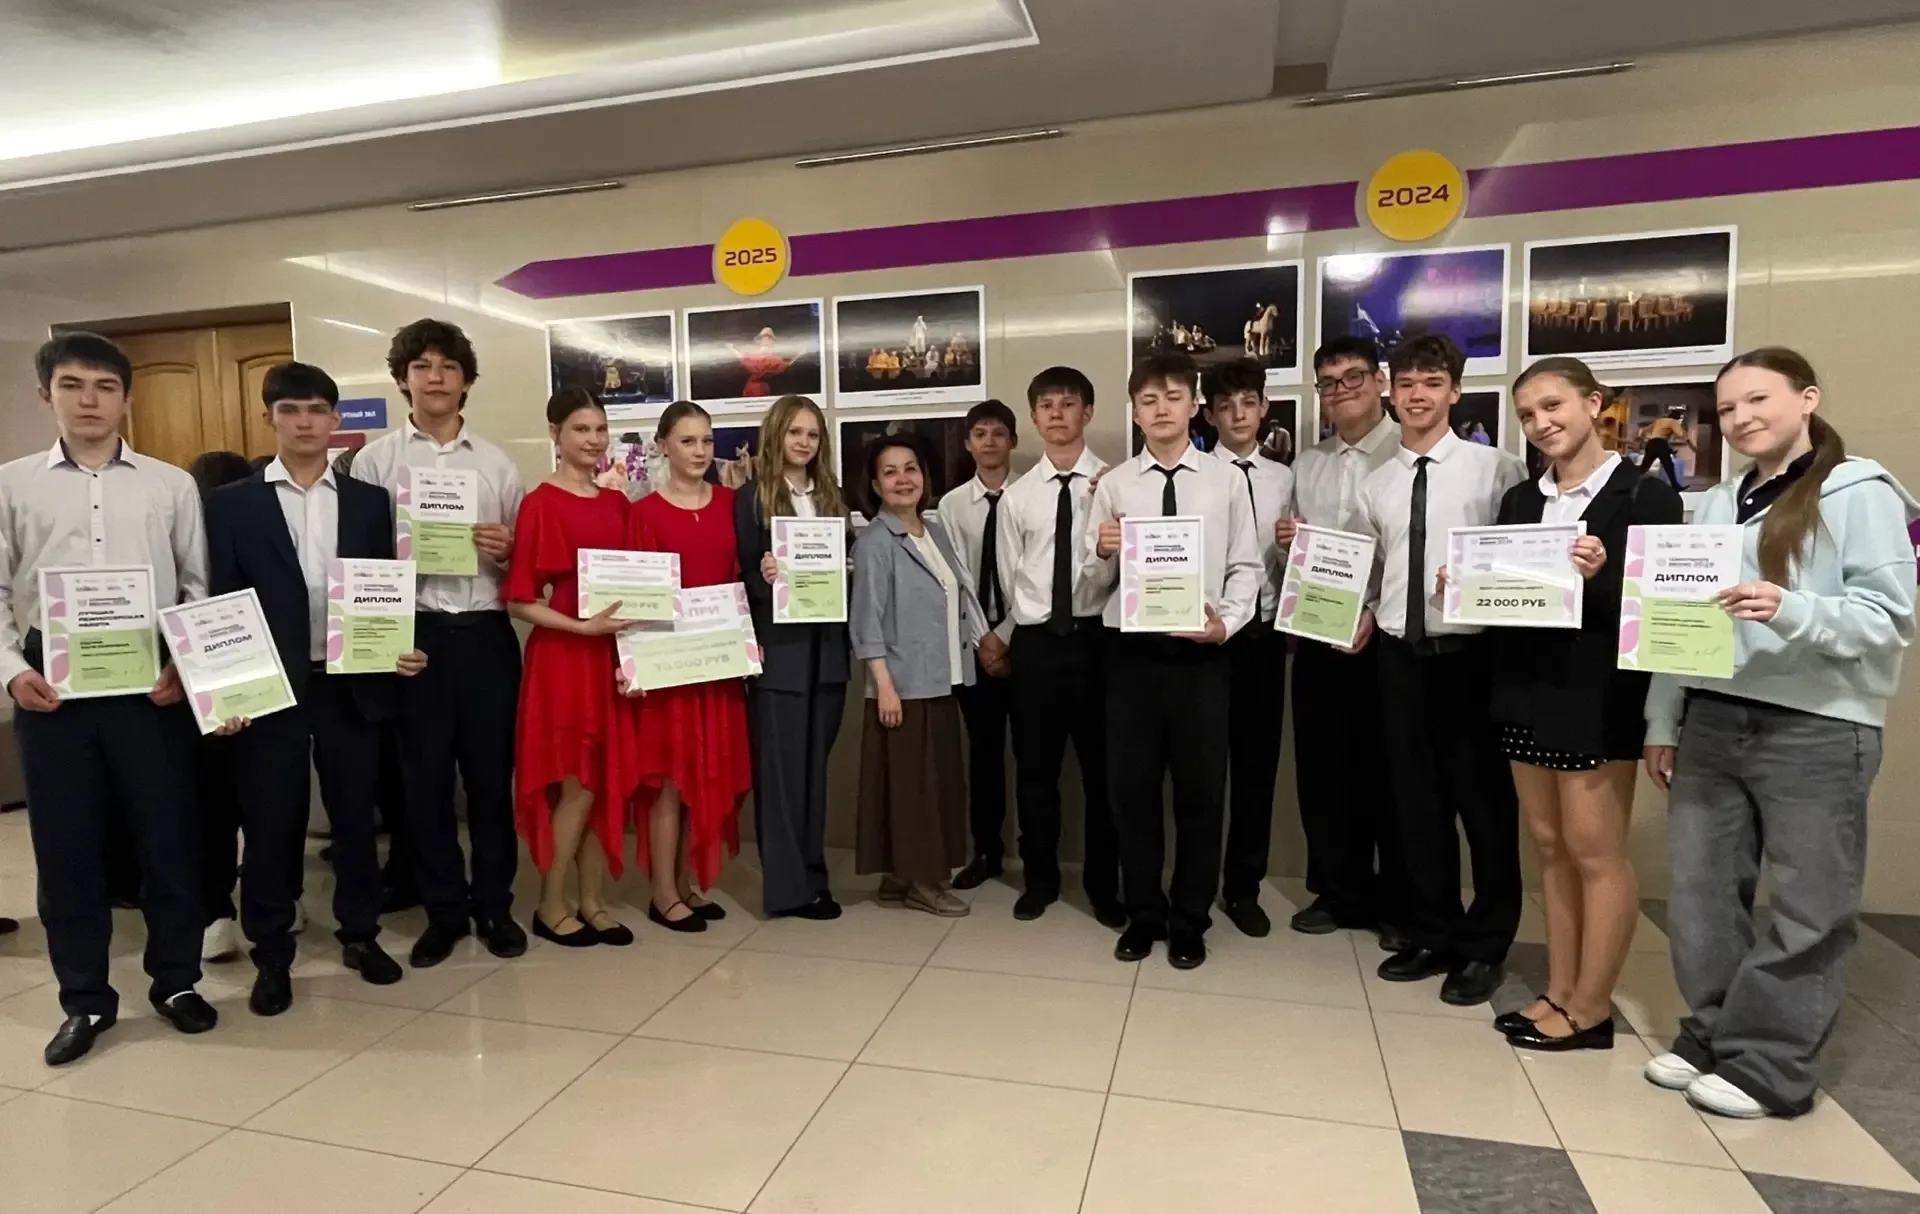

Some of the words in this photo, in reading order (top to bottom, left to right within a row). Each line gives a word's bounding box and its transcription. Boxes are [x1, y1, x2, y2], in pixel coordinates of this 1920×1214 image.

[1377, 183, 1450, 208] 2024
[725, 247, 777, 267] 2025
[420, 502, 465, 511] ДИПЛОМ
[1145, 556, 1189, 564] ДИПЛОМ
[1311, 565, 1353, 580] ДИПЛОМ
[1654, 573, 1719, 583] ДИПЛОМ
[353, 596, 402, 604] ДИПЛОМ
[1476, 599, 1491, 607] 22
[1493, 599, 1519, 607] 000
[1521, 599, 1546, 608] РУБ
[204, 634, 253, 653] ДИПЛОМ
